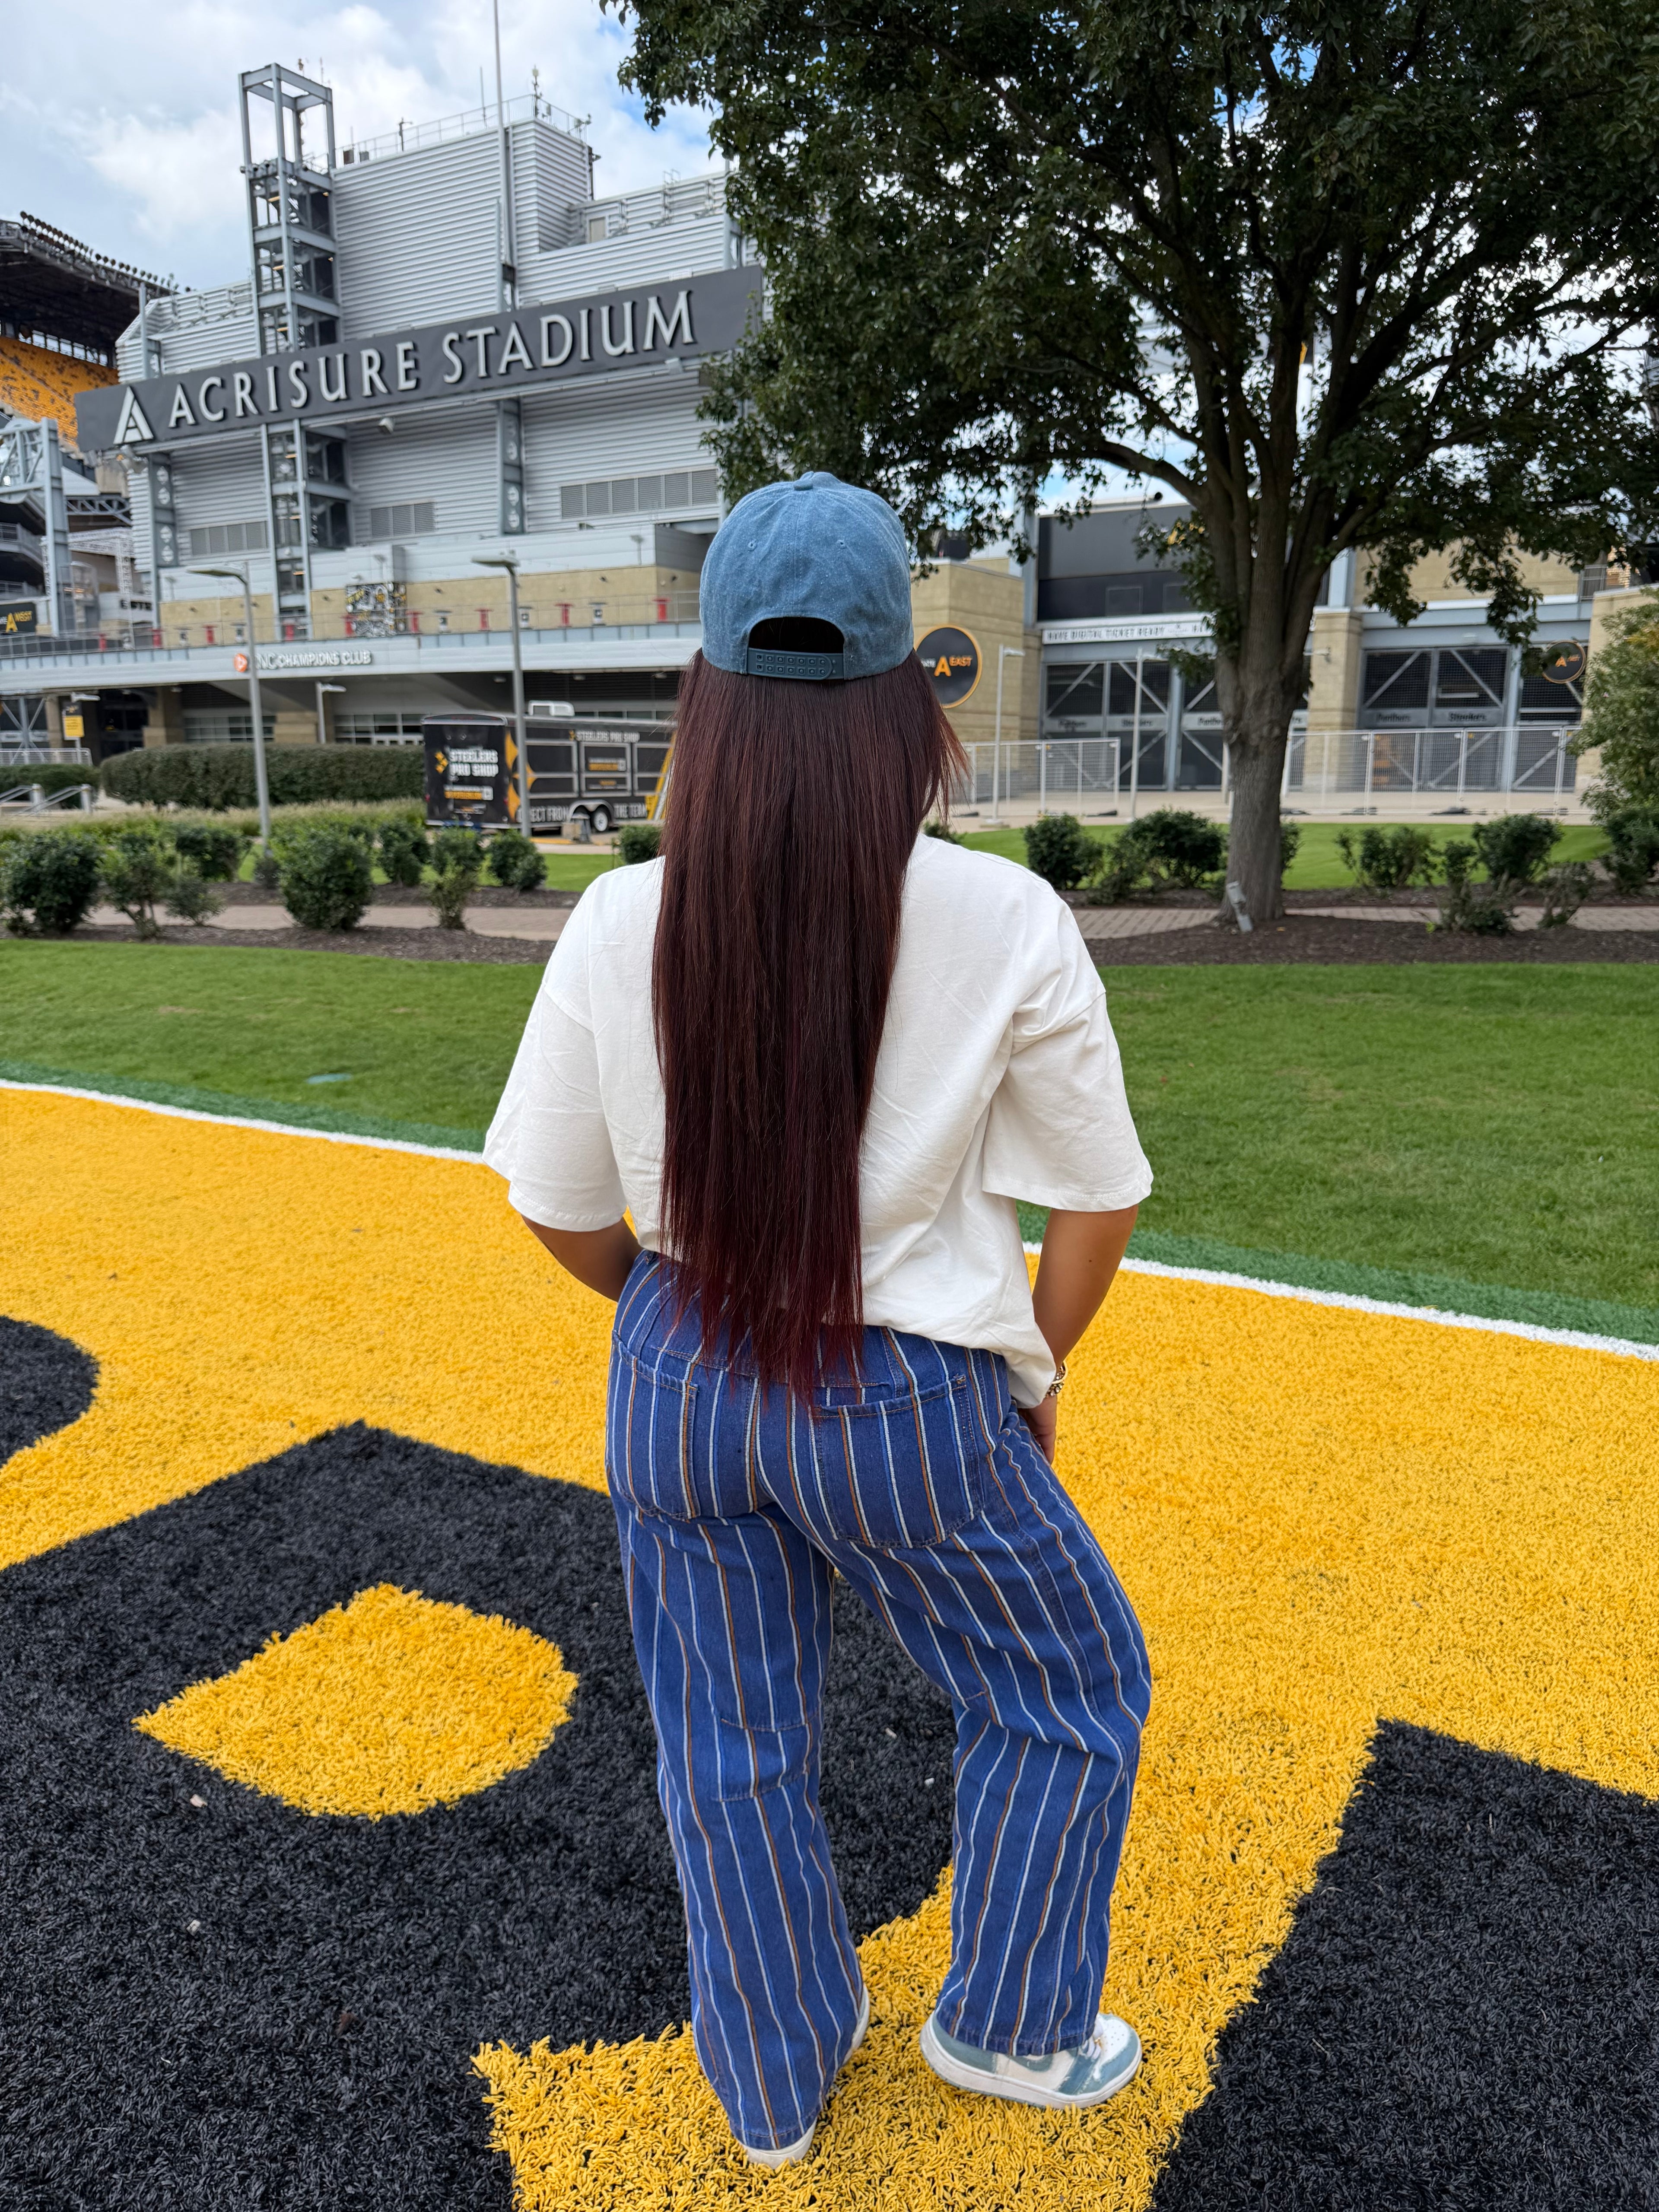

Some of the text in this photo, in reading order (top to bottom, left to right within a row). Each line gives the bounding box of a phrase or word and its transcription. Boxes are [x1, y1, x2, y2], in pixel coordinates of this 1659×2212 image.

[168, 341, 418, 429] ACRISURE
[442, 290, 694, 384] STADIUM
[6, 613, 18, 633] A
[277, 650, 340, 667] CHAMPIONS
[340, 649, 372, 665] CLUB
[934, 655, 952, 677] A
[949, 655, 973, 667] EAST
[576, 730, 609, 742] STEELERS
[449, 748, 498, 763] STEELERS
[449, 763, 499, 777] PRO SHOP
